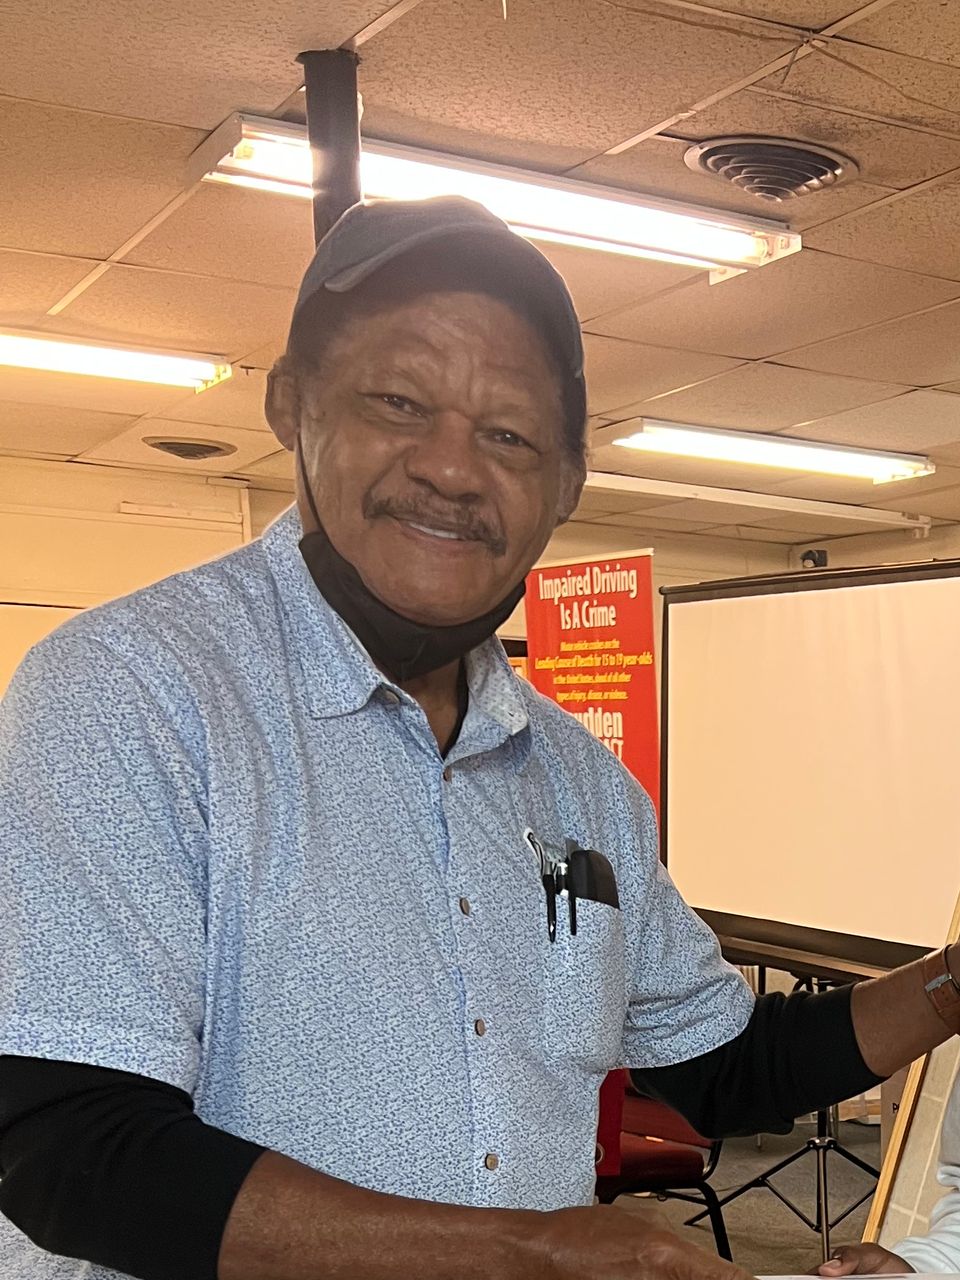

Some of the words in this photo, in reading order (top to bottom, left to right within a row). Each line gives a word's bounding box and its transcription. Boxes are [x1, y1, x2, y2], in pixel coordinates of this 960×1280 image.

[538, 566, 592, 605] Impaired
[592, 563, 638, 599] Driving
[560, 602, 571, 630] Is
[572, 601, 580, 629] A
[581, 600, 617, 628] Crime
[574, 707, 623, 738] dden
